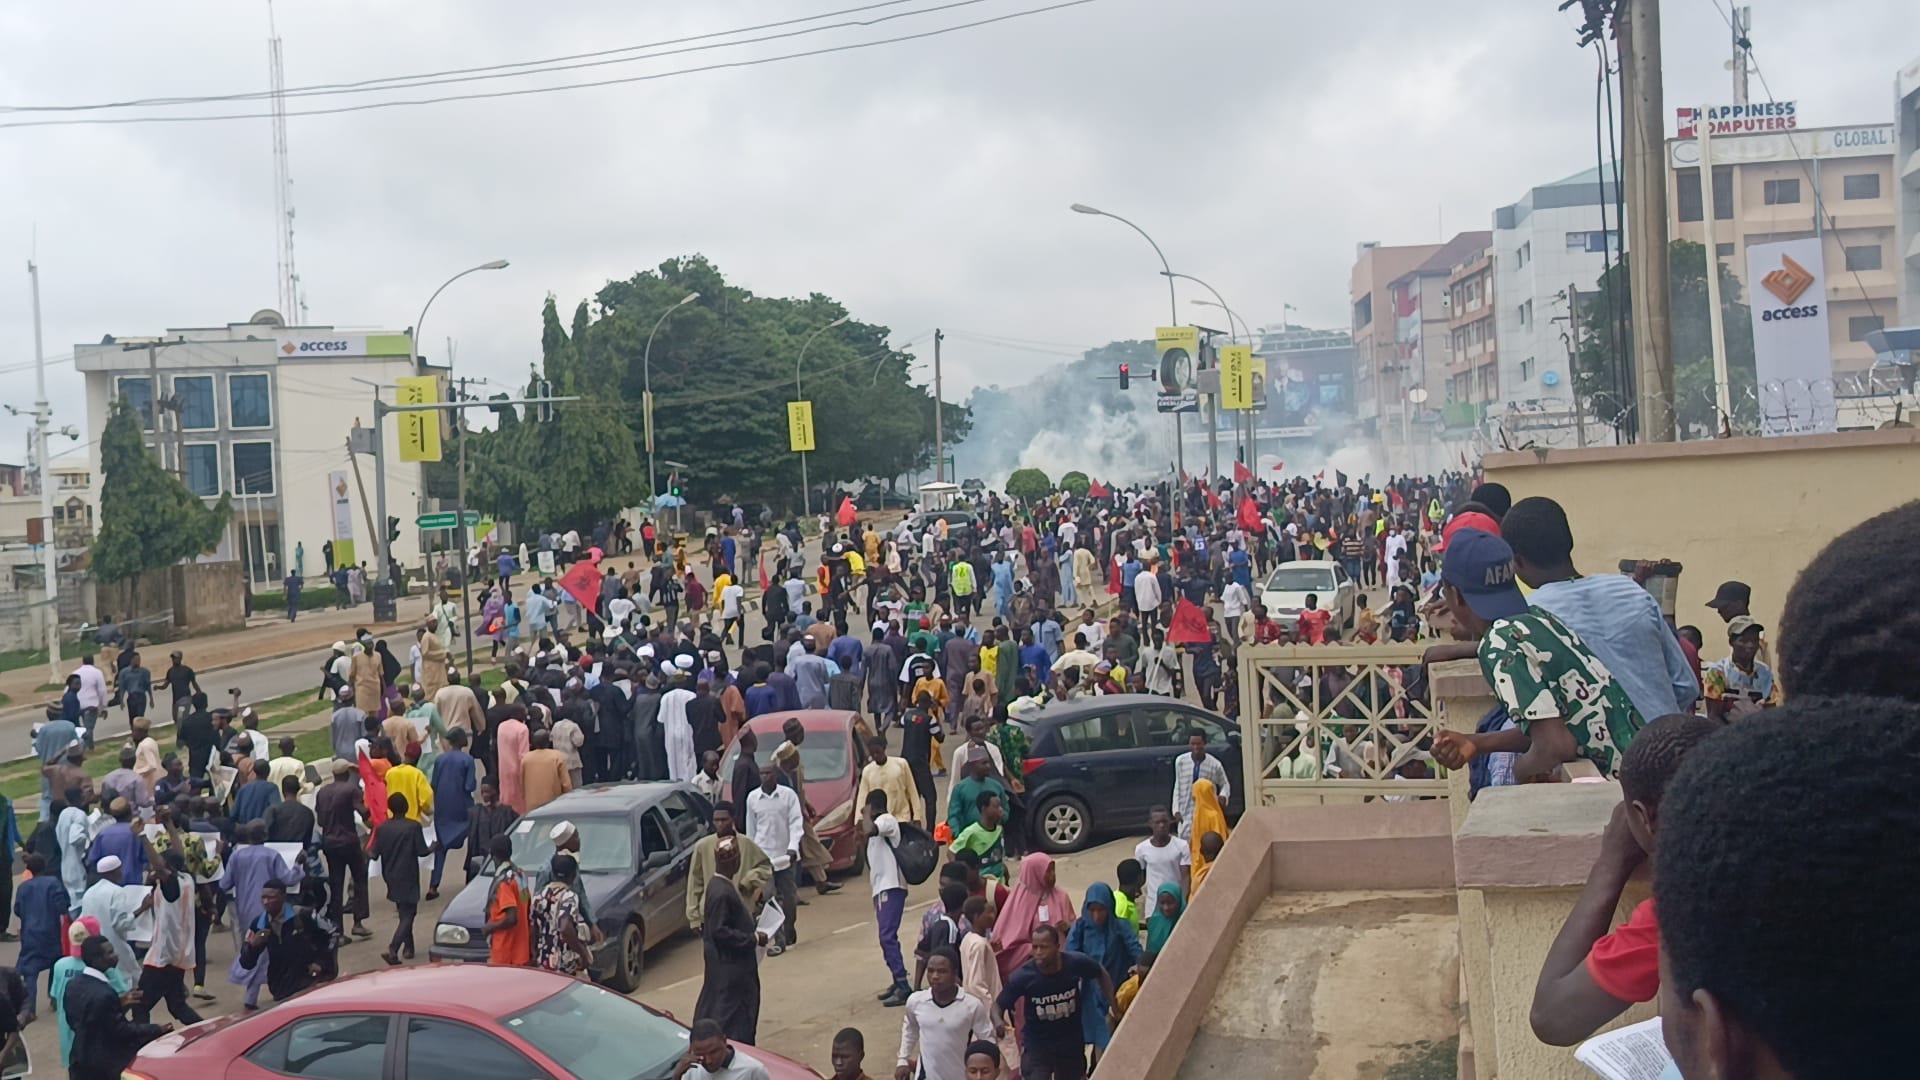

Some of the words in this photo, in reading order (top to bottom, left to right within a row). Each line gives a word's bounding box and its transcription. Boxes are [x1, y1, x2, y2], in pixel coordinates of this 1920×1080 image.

[1693, 102, 1796, 120] HAPPINESS
[1834, 129, 1887, 147] GLOBAL
[1762, 305, 1818, 321] access
[300, 341, 347, 351] access
